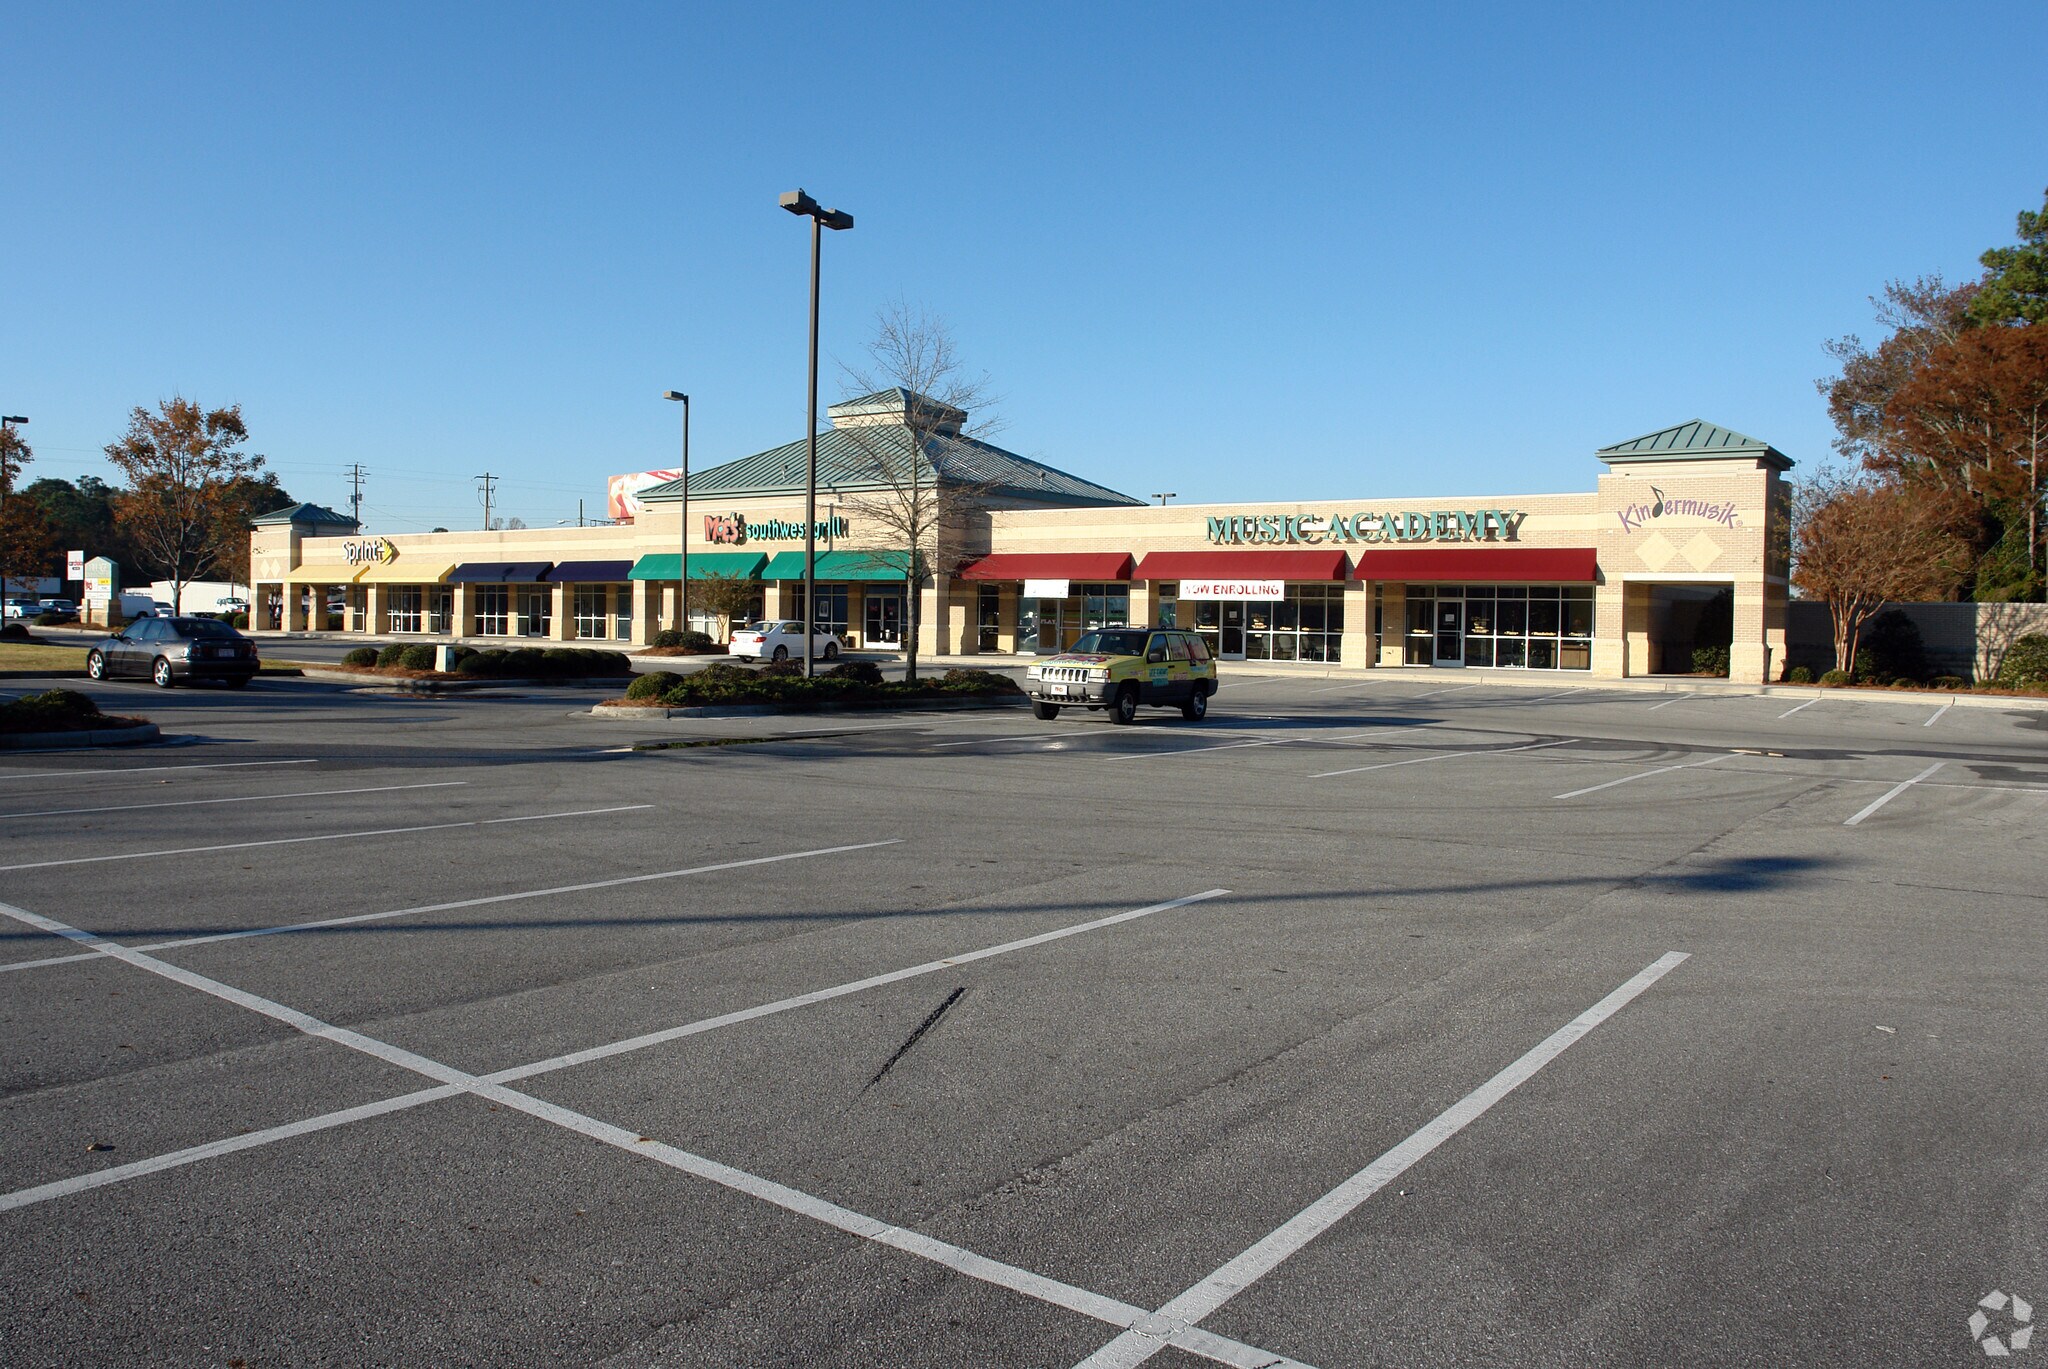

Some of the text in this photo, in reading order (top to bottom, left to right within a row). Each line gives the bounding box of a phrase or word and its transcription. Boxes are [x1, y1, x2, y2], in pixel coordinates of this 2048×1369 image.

[1616, 485, 1739, 535] Kindermusik
[746, 519, 806, 539] southwes
[814, 516, 841, 540] grill
[1204, 508, 1519, 542] MUSIC ACADEMY
[342, 540, 379, 565] Sprint
[1213, 584, 1280, 595] ENROLLING
